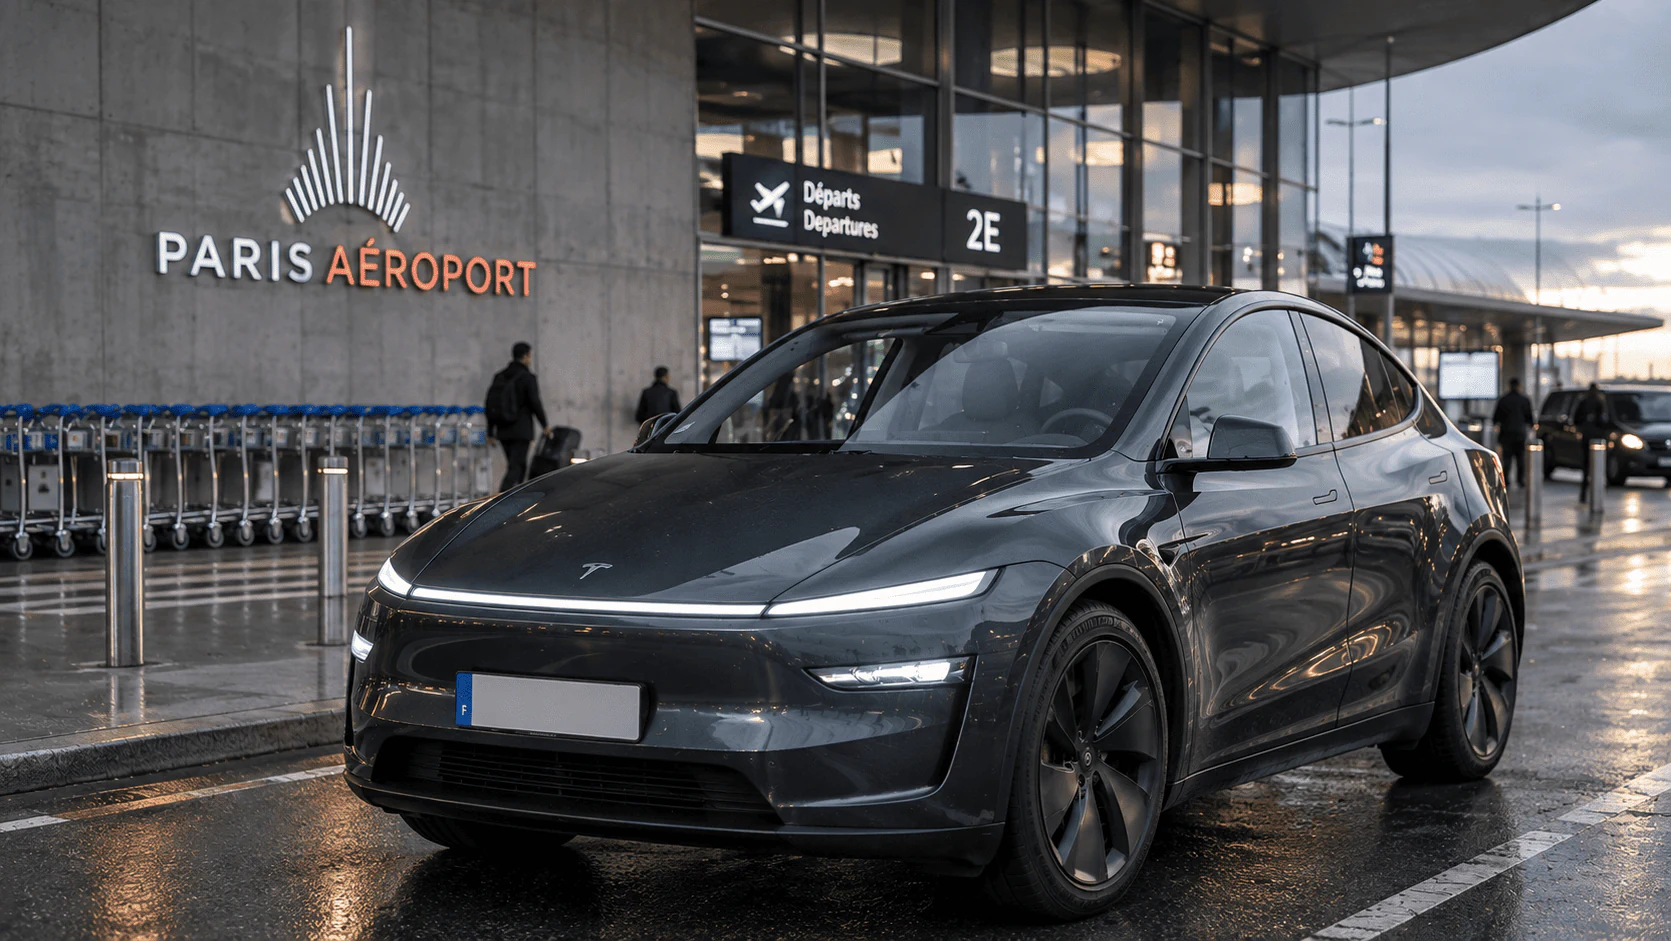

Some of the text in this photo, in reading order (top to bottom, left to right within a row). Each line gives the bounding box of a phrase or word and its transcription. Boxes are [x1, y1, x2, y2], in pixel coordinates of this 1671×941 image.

[803, 180, 861, 211] Départs
[803, 209, 879, 240] Departures
[966, 208, 1002, 254] 2E
[155, 231, 537, 297] PARIS AÉROPORT
[461, 704, 468, 716] F
